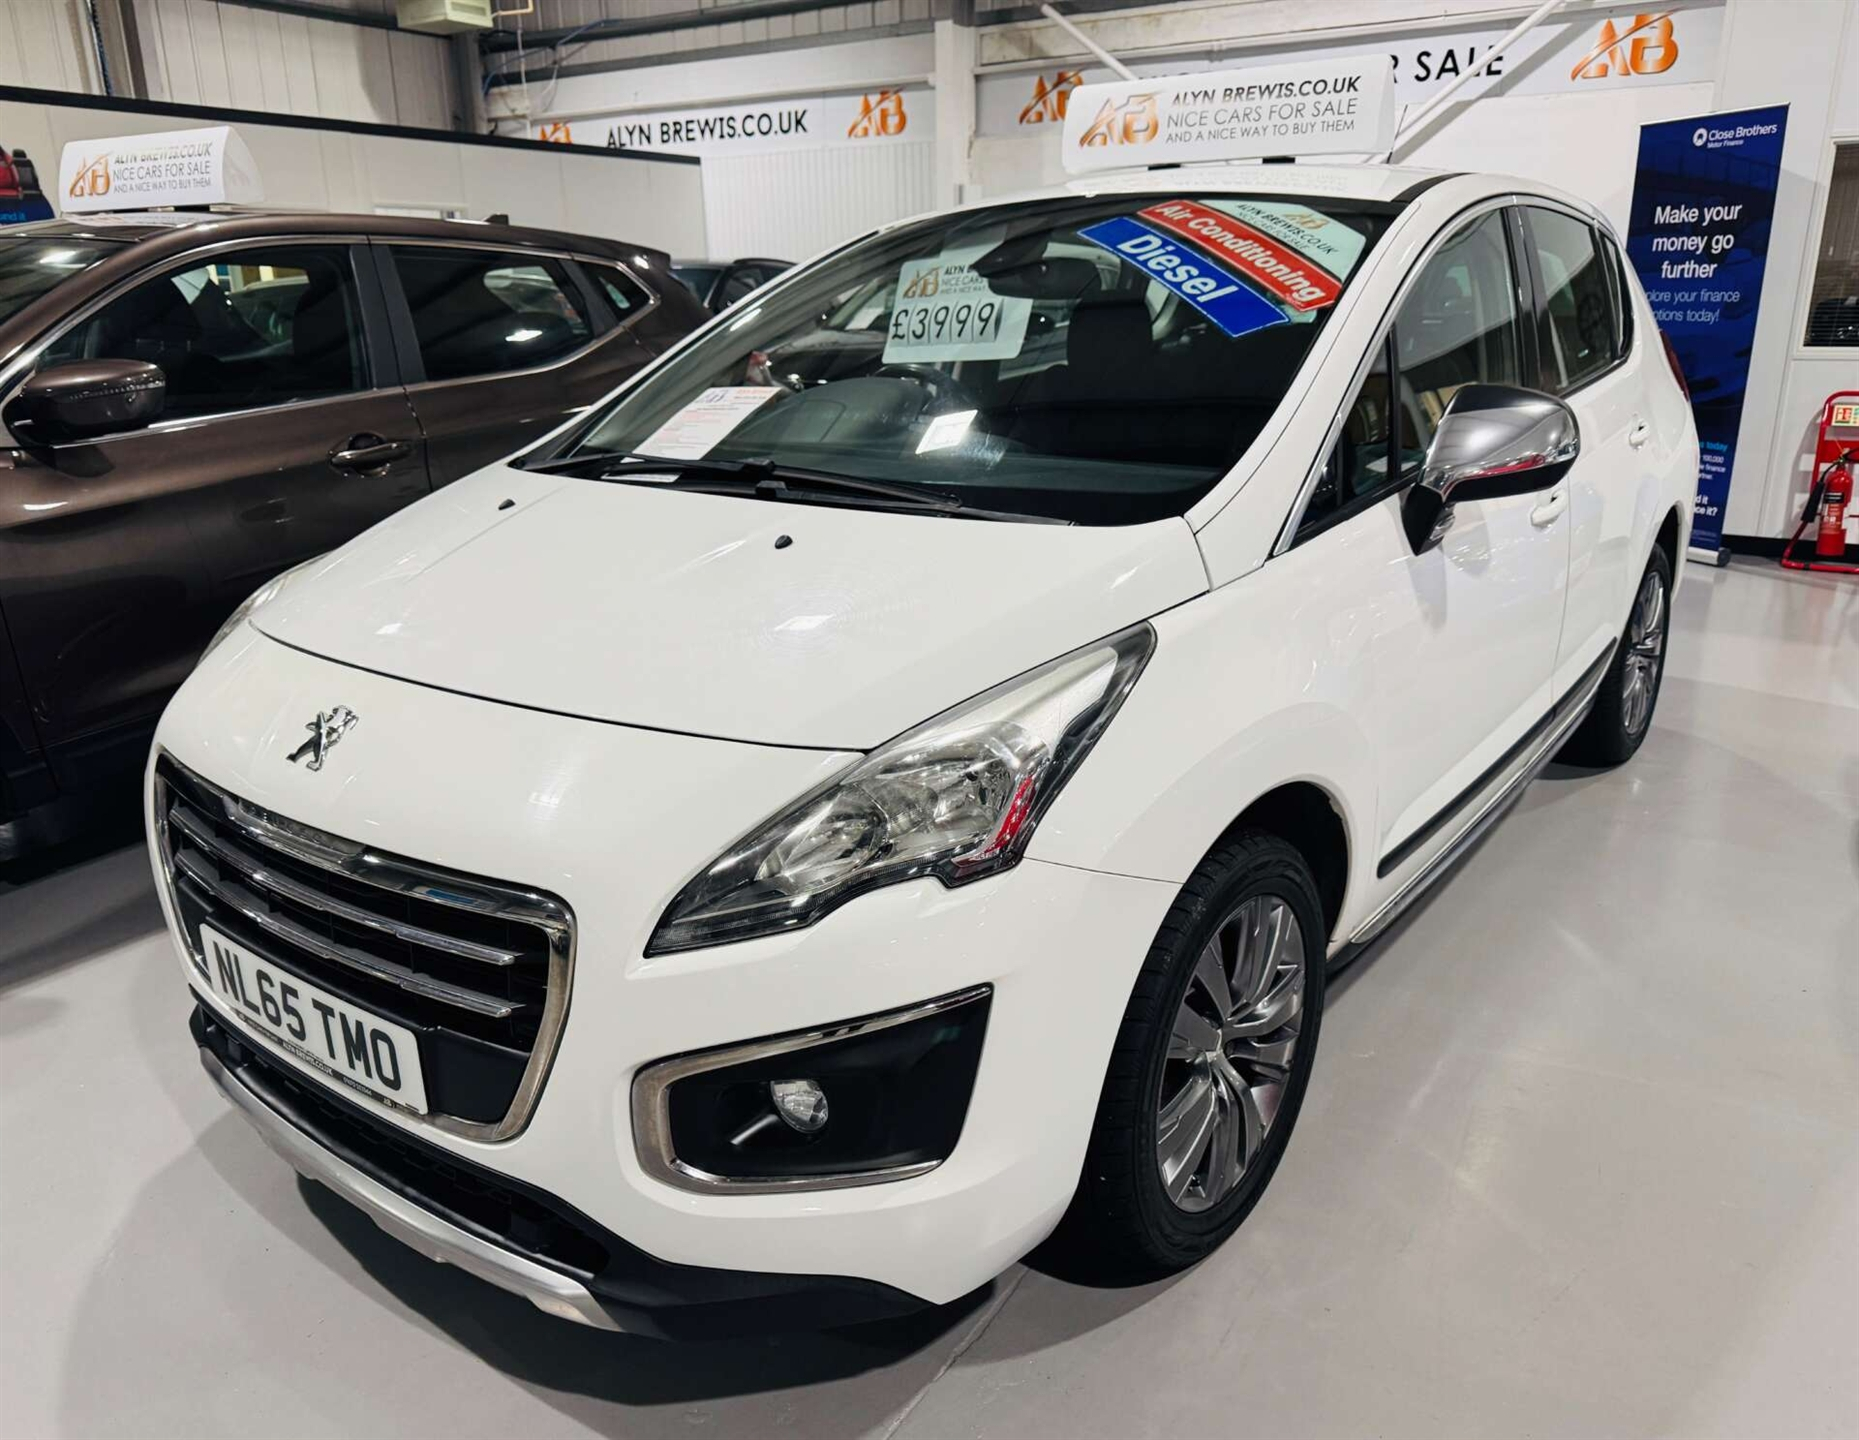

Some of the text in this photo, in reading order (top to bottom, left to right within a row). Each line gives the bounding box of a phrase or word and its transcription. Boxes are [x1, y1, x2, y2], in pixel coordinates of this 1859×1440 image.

[1172, 75, 1362, 106] ALYN BREWIS.CO.UK
[1166, 97, 1359, 129] NICE CARS FOR SALE
[608, 109, 809, 149] ALYN BREWIS.CO.UK
[1165, 119, 1355, 144] AND A NICE WAY TO BUY THEM
[1708, 124, 1778, 141] Close Brothers
[113, 160, 211, 181] NICE CARS FOR SALE
[113, 184, 128, 194] AND
[136, 182, 151, 192] NICE
[153, 181, 167, 191] WAY
[168, 180, 178, 190] TO
[179, 179, 192, 189] BUY
[193, 177, 212, 188] THEM
[1654, 204, 1742, 226] Make your
[1154, 203, 1326, 303] Air Conditioning
[1652, 234, 1735, 254] money go
[944, 265, 966, 275] ALYN
[1116, 234, 1239, 304] Diesel
[1661, 260, 1718, 279] further
[1673, 291, 1698, 305] your
[1700, 288, 1741, 302] finance
[892, 303, 995, 340] £3999
[1686, 307, 1720, 325] today!
[213, 940, 402, 1091] NL65 TMO
